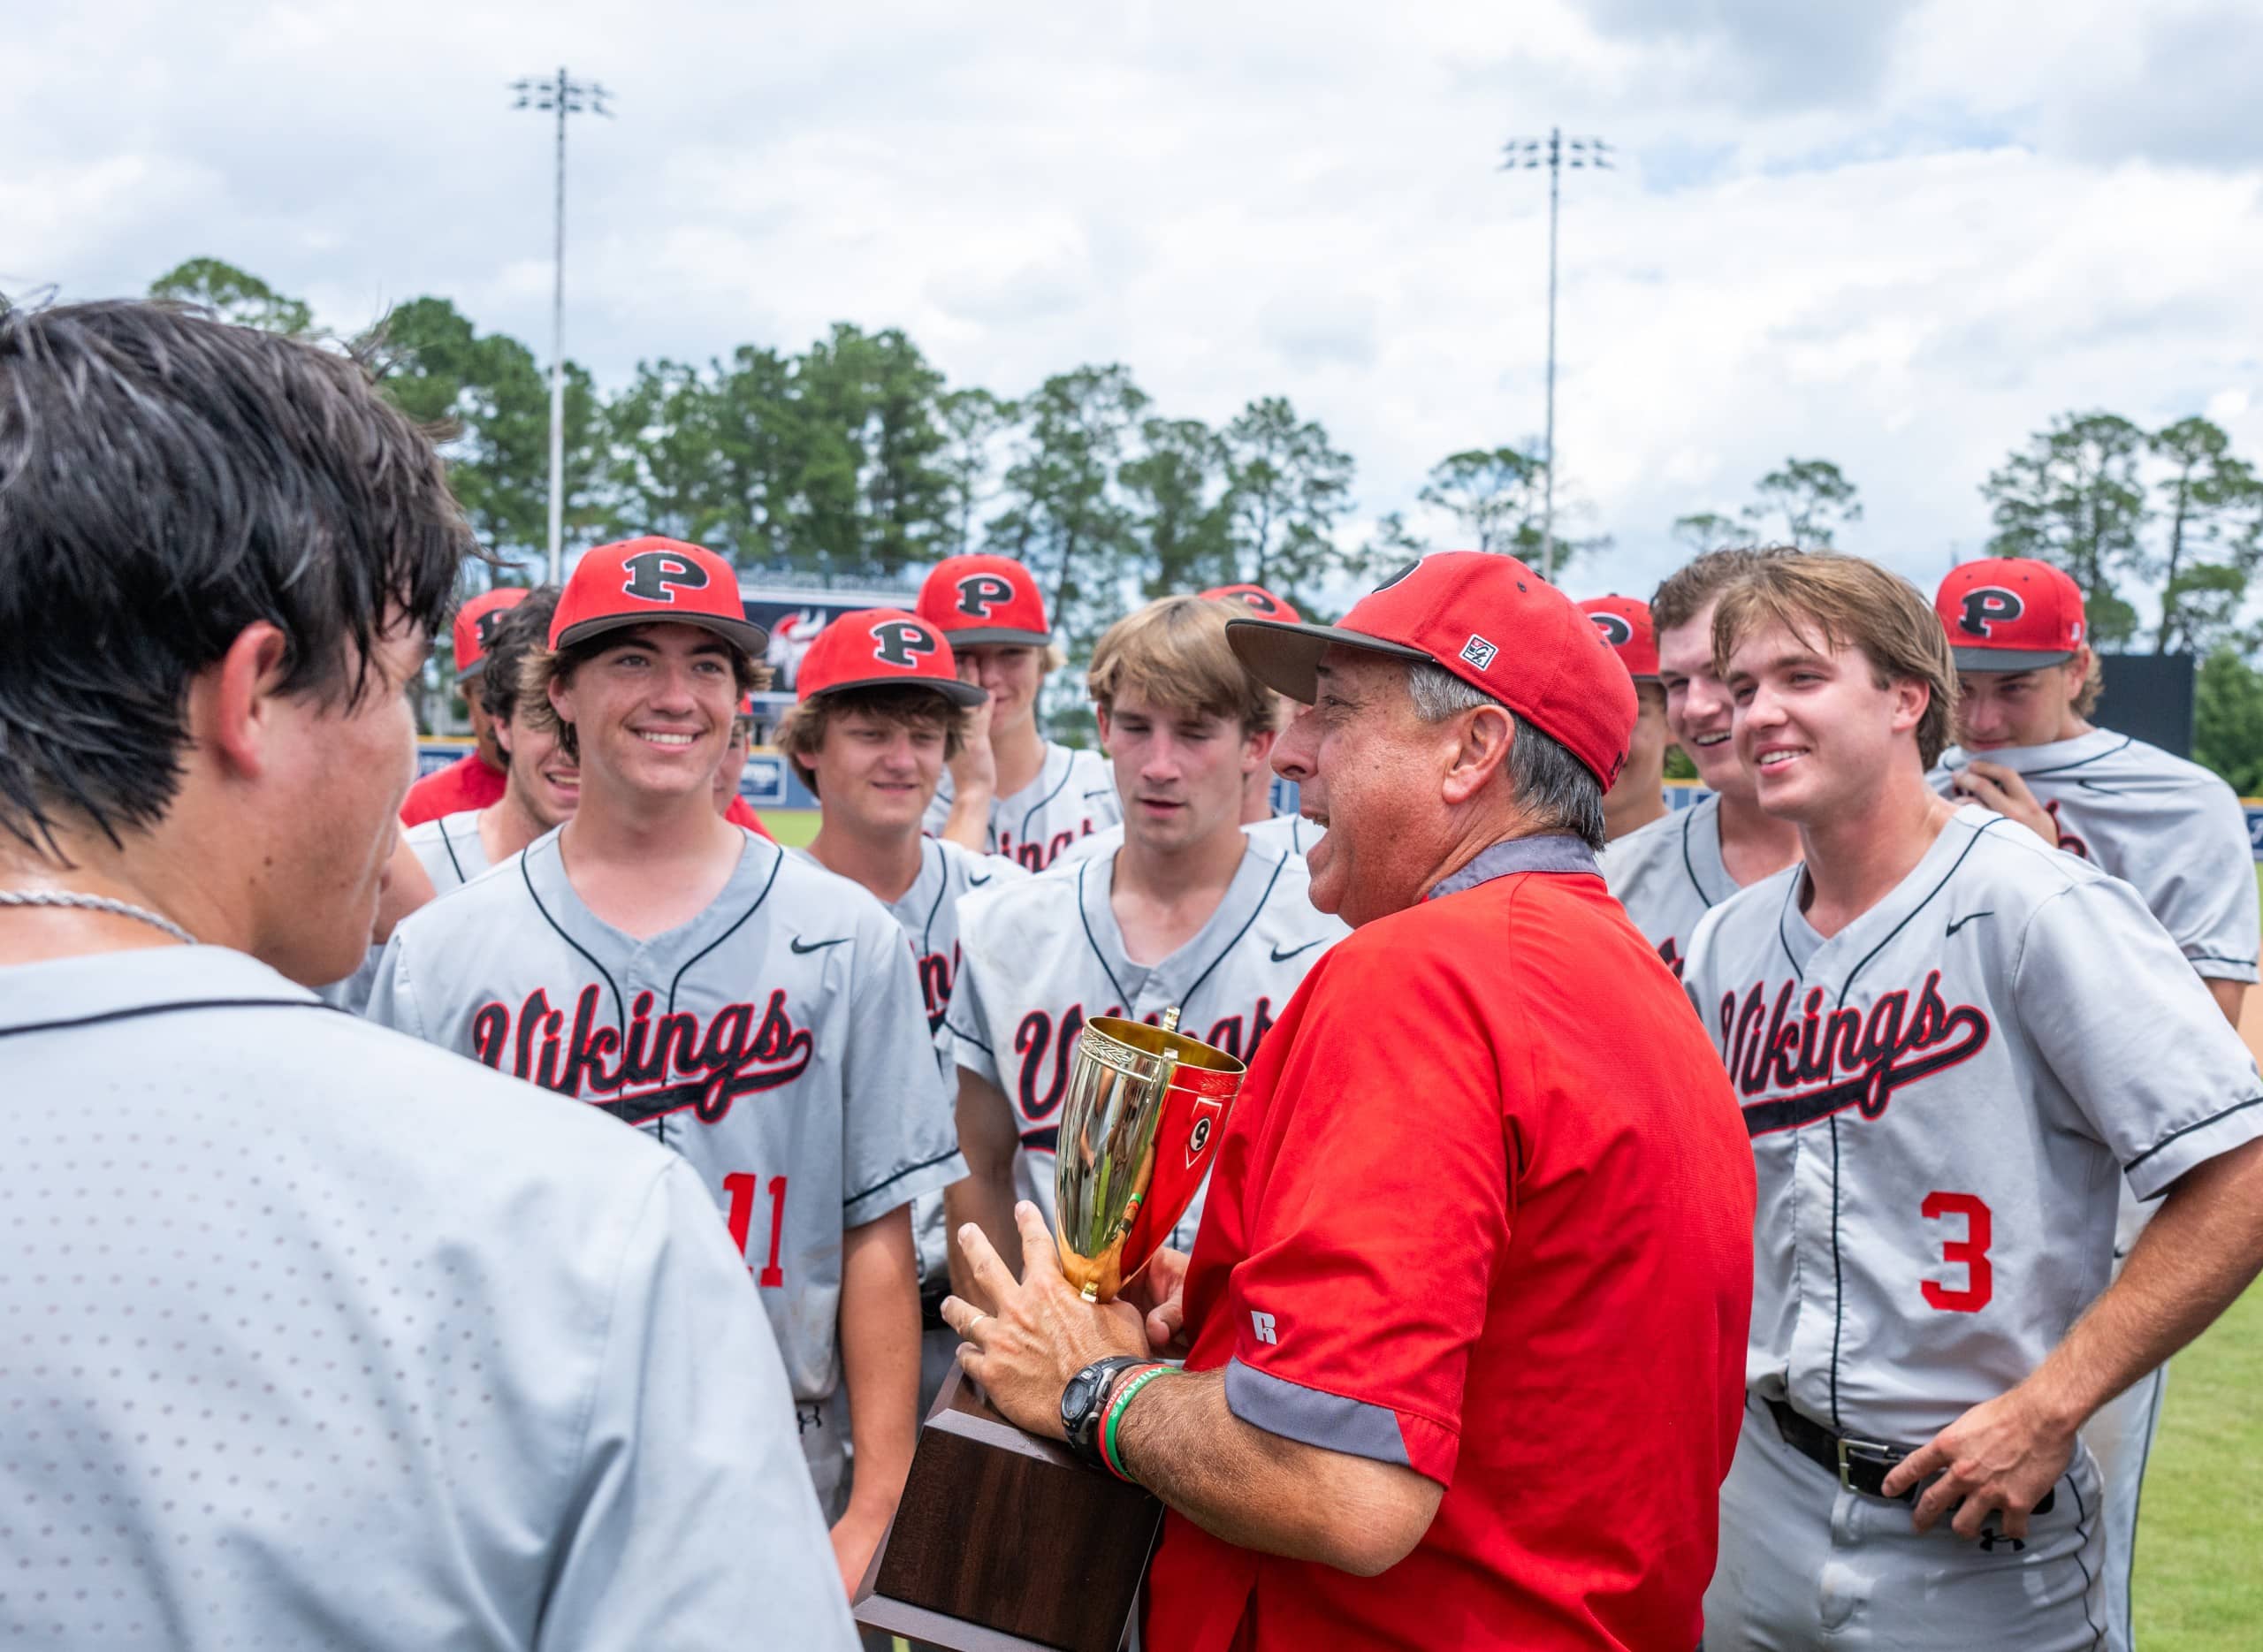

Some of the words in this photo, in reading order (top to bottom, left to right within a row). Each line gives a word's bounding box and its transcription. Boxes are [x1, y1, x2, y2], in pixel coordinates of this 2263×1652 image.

[621, 550, 710, 603] P
[955, 572, 1015, 619] P
[1959, 585, 2024, 637] P
[869, 619, 937, 668] P
[473, 983, 812, 1124] Vikings
[1720, 969, 1990, 1123] Vikings
[722, 1171, 789, 1288] 11
[1920, 1191, 1993, 1313] 3
[1250, 1309, 1277, 1344] R
[1116, 1367, 1162, 1405] FAMILY
